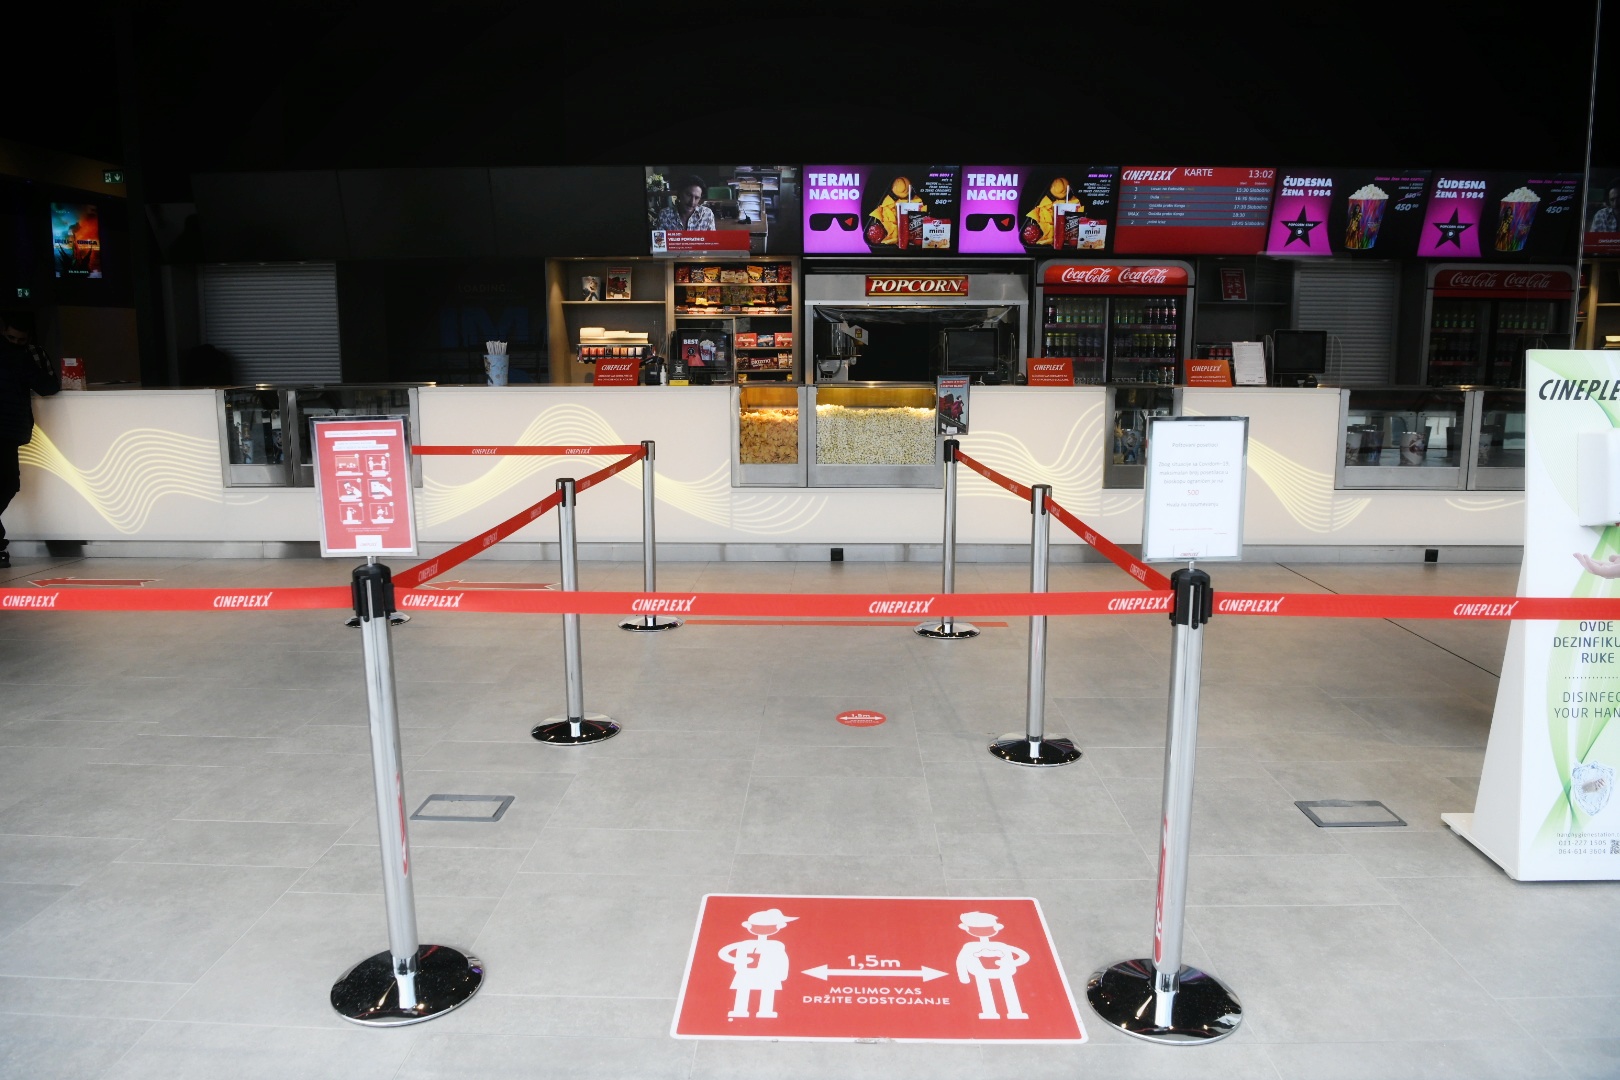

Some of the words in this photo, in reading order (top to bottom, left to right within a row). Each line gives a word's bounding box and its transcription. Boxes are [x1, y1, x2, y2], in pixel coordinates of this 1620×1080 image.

[808, 174, 860, 186] TERMI
[968, 174, 1018, 186] TERMI
[1122, 168, 1178, 180] CINEPLEXX
[1184, 168, 1214, 177] KARTE
[1249, 170, 1274, 178] 13:02
[1283, 176, 1332, 187] ČUDESNA
[1437, 178, 1486, 190] ČUDESNA
[809, 188, 860, 200] NACHO
[966, 190, 1018, 201] NACHO
[1281, 188, 1304, 196] ŽENA
[1435, 190, 1458, 198] ŽENA
[1062, 267, 1113, 283] Coca-Cola
[1118, 268, 1170, 284] Coca-Cola
[1450, 272, 1500, 287] Coca-Cola
[1504, 272, 1552, 288] Coca-Cola
[870, 279, 962, 292] POPCORN
[2, 592, 59, 608] CINEPLEXX
[213, 592, 273, 608] CINEPLEXX
[402, 592, 464, 608] CINEPLEXX
[631, 596, 696, 612] CINEPLEXX
[868, 597, 935, 614] CINEPLEXX
[1108, 593, 1174, 611] CINEPLEXX
[1218, 597, 1285, 612] CINEPLEXX
[1453, 601, 1519, 616] CINEPLEXX
[1580, 621, 1613, 632] OVDE
[1582, 653, 1614, 663] RUKE
[1554, 708, 1588, 718] YOUR
[847, 955, 901, 969] 1,5m
[829, 986, 890, 995] MOLIMO
[893, 987, 922, 995] VAS
[802, 994, 852, 1004] DRŽITE
[858, 995, 950, 1005] ODSTOJANJE
